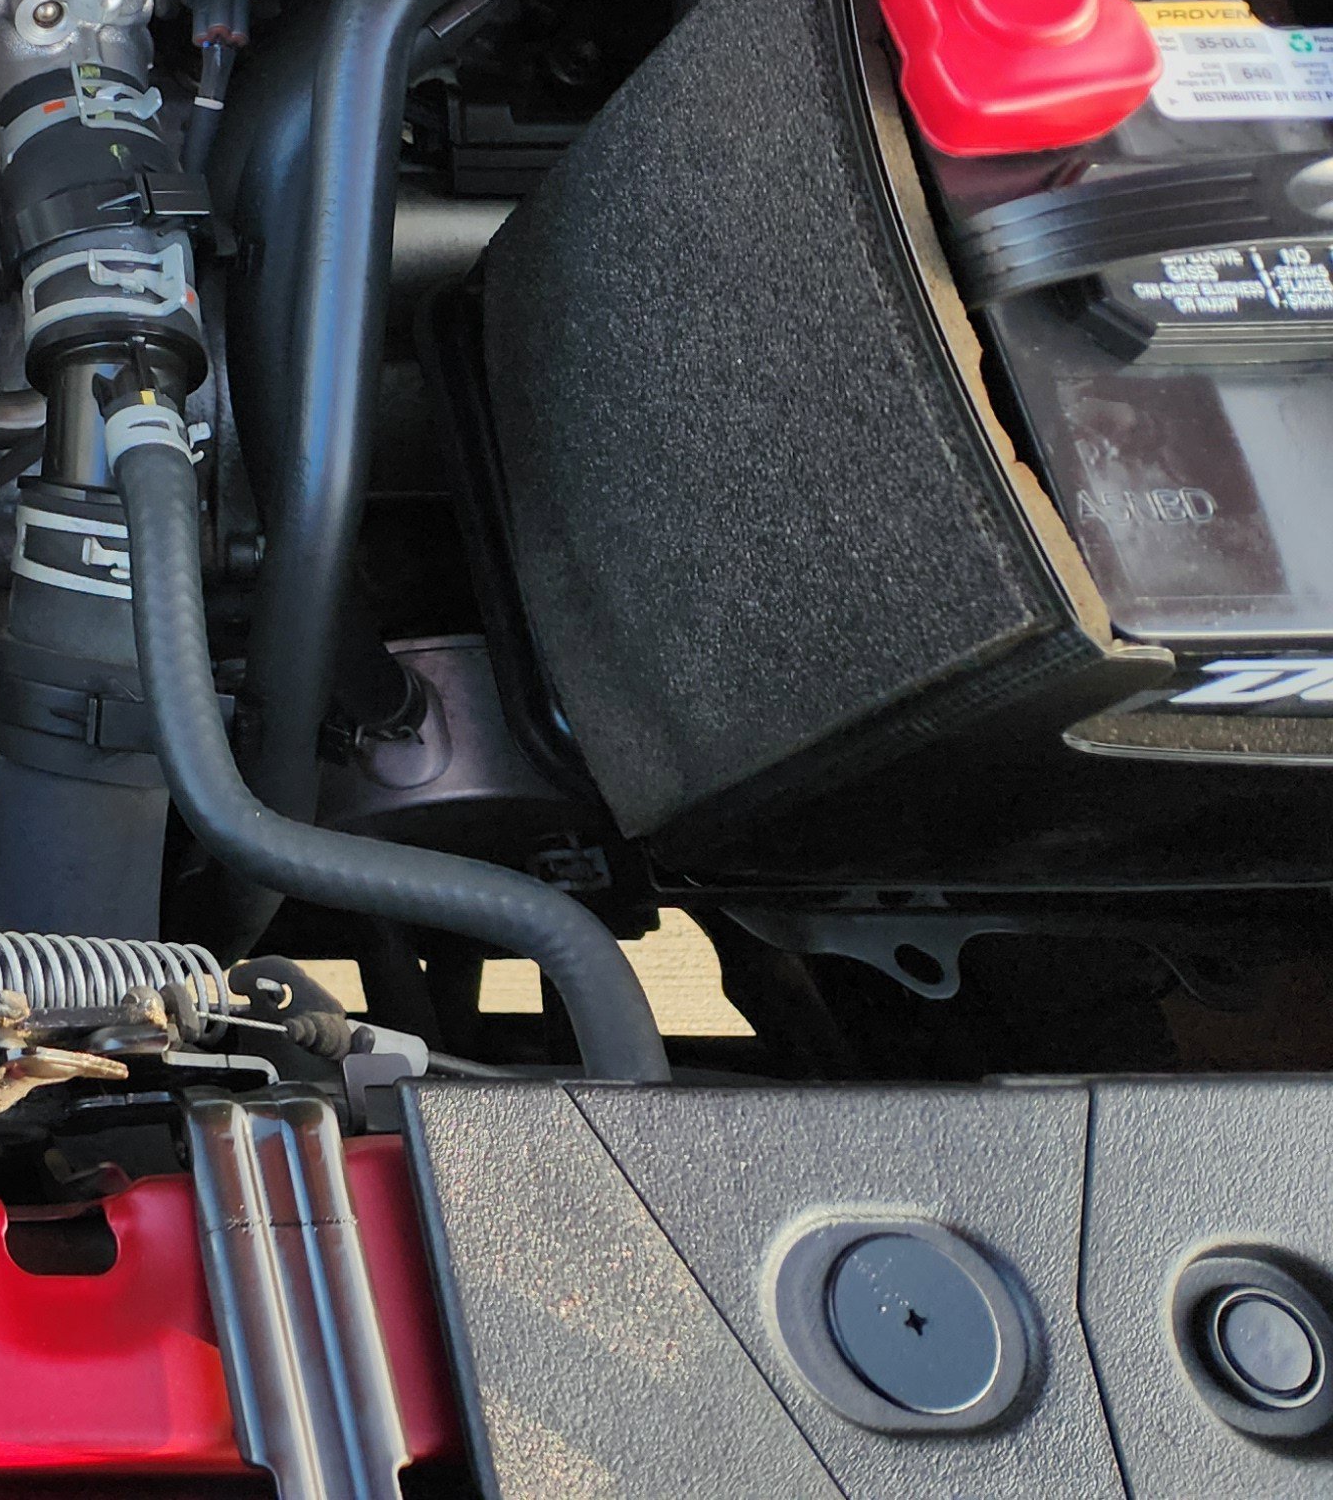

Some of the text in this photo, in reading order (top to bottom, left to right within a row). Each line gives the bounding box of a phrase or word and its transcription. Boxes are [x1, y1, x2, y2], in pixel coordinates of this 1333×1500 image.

[1279, 245, 1311, 266] NO
[1164, 264, 1219, 282] GASES
[1160, 281, 1201, 298] CAUSE
